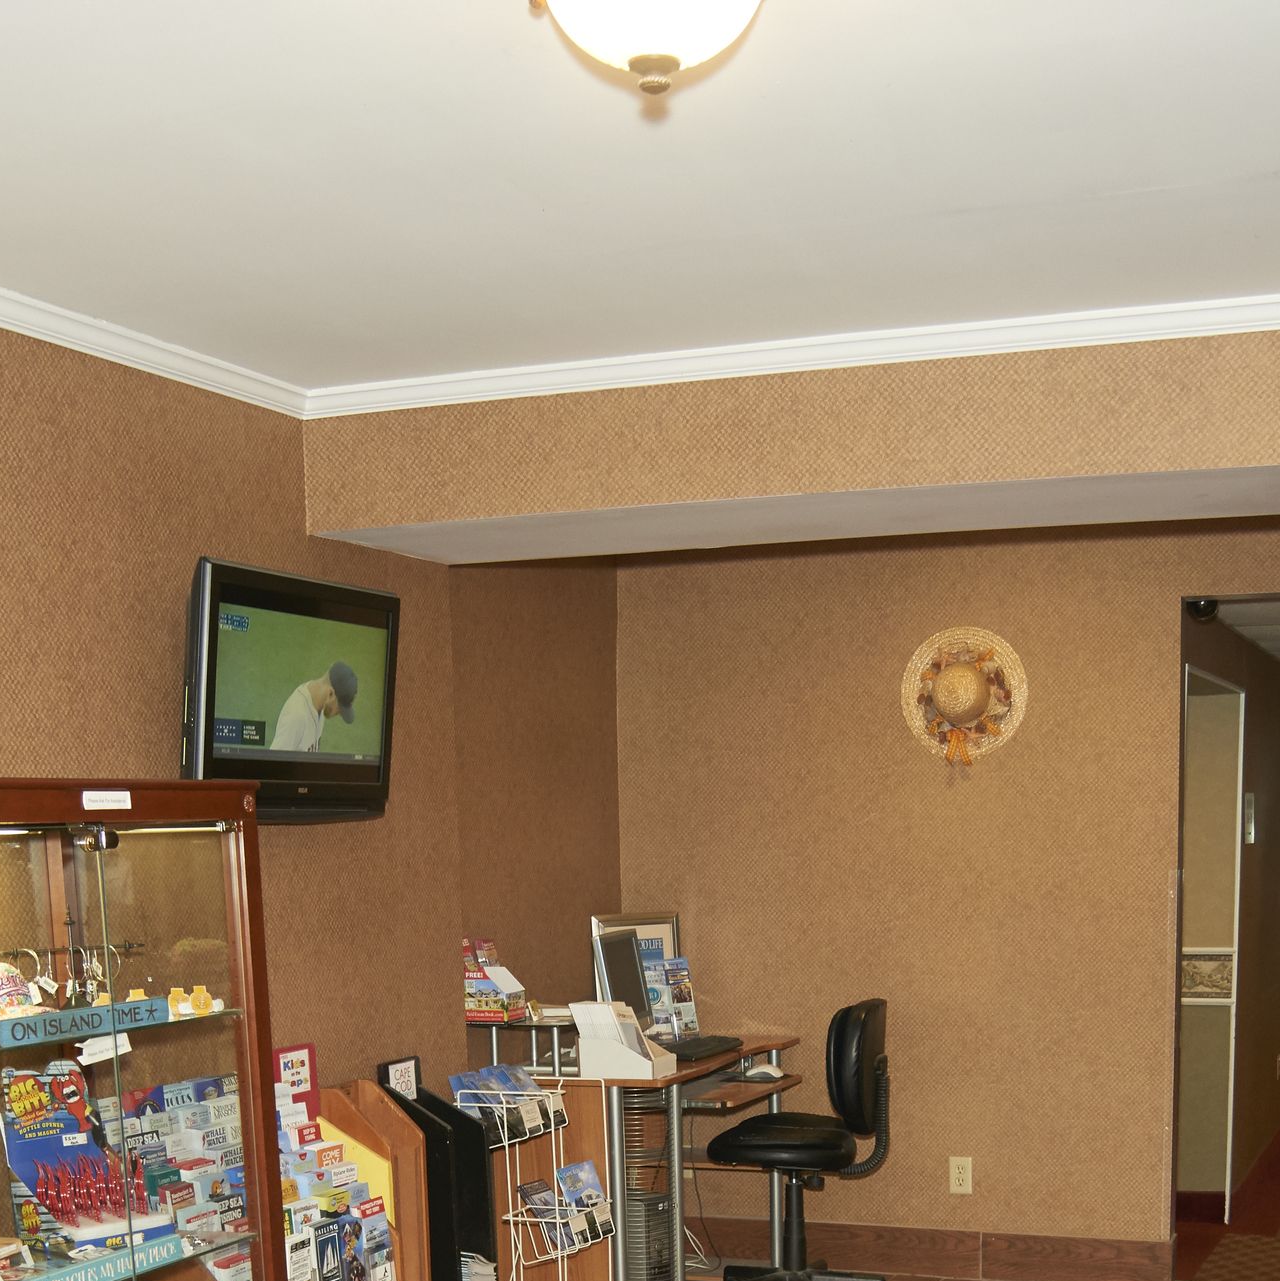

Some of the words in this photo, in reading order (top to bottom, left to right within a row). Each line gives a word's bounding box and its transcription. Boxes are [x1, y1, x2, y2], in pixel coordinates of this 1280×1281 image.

[649, 940, 663, 949] LIFE
[11, 1022, 38, 1041] ON
[43, 1012, 102, 1038] ISLAND
[283, 1059, 305, 1071] Kids
[395, 1067, 411, 1080] CAPE
[10, 1078, 38, 1101] BIG
[395, 1081, 412, 1092] COD
[11, 1091, 51, 1117] BITE
[19, 1123, 40, 1134] BOTTLE
[38, 1129, 60, 1137] MAGNET
[204, 1127, 226, 1140] WHALE
[126, 1137, 142, 1148] DEEP
[144, 1132, 159, 1144] SEA
[207, 1136, 227, 1147] WATCH
[223, 1148, 243, 1158] WHALE
[322, 1148, 340, 1160] COME
[225, 1156, 243, 1167] WATCH
[230, 1196, 243, 1207] SEA
[315, 1224, 338, 1236] SAILING
[106, 1237, 122, 1247] BIG
[100, 1261, 115, 1277] MY
[148, 1243, 177, 1265] PLACE
